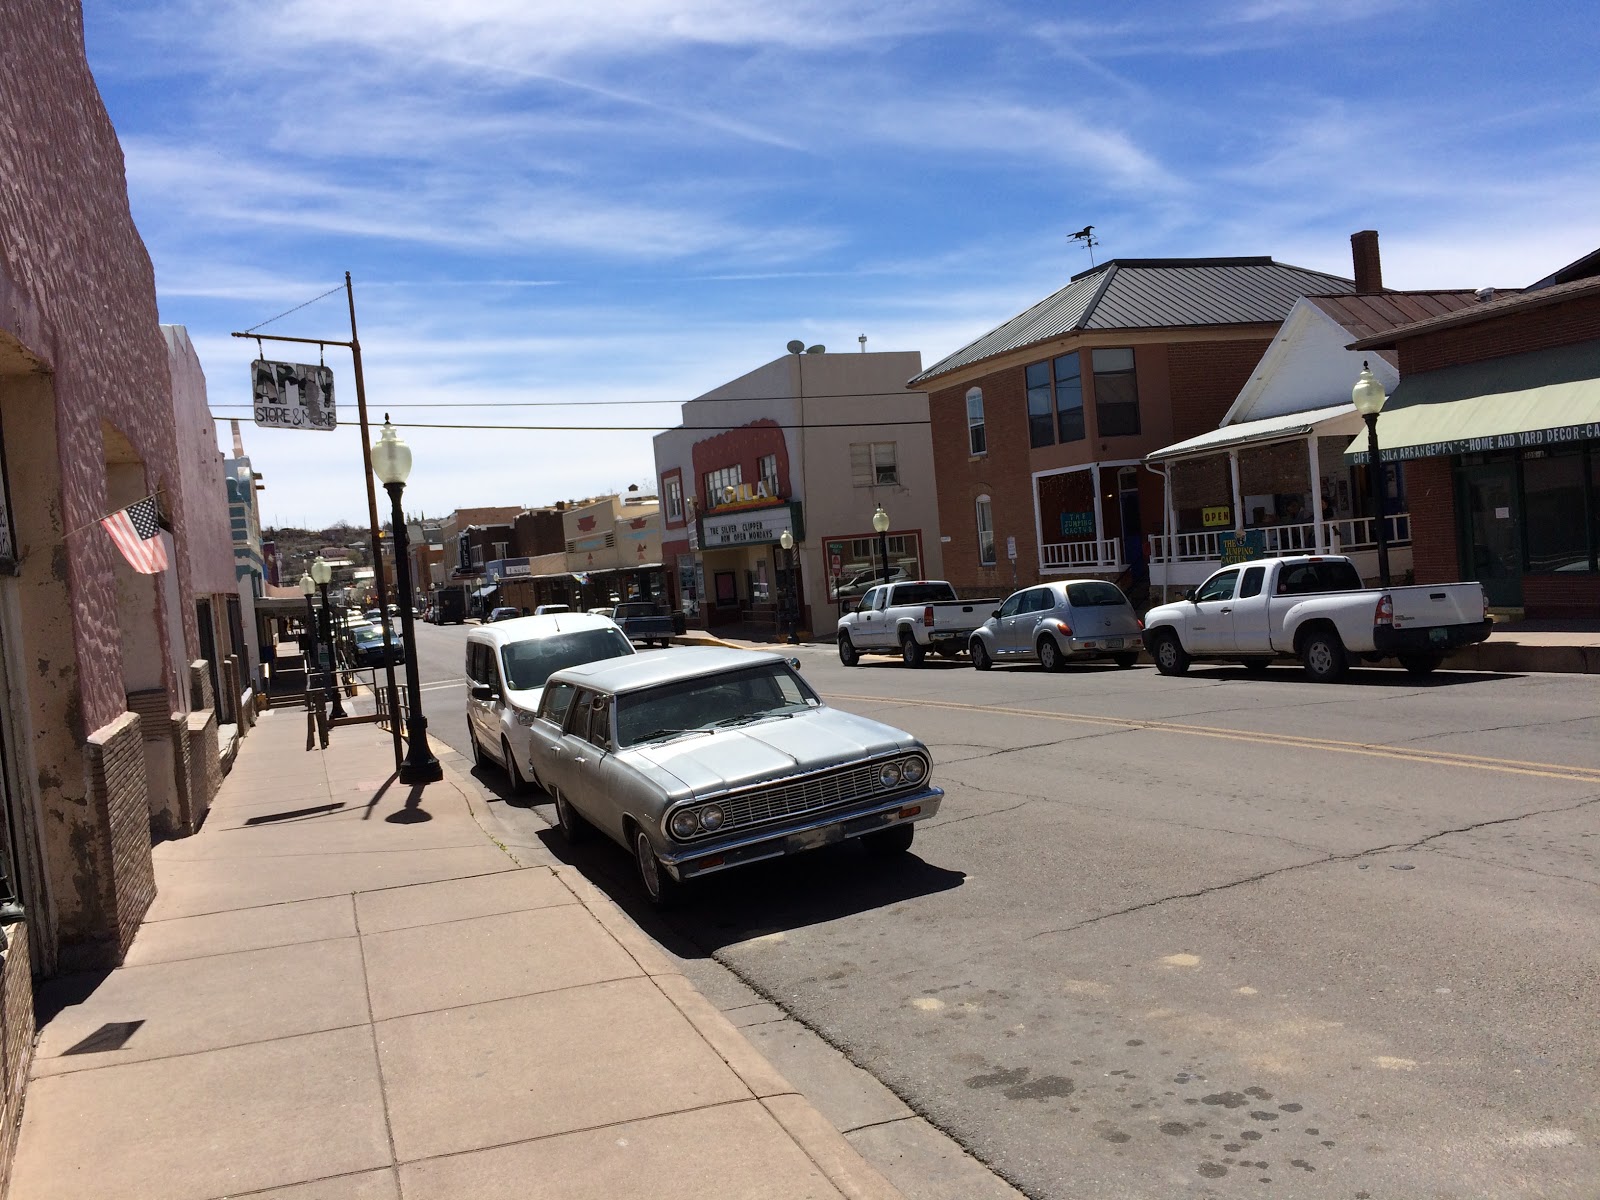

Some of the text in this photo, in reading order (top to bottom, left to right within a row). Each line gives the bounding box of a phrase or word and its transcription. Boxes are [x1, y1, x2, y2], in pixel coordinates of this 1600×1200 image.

[256, 407, 291, 423] STORE
[1497, 434, 1516, 448] AND
[1519, 430, 1543, 446] YARD
[722, 480, 772, 504] GILA
[1204, 511, 1229, 522] OPEN
[721, 525, 737, 533] SILVER
[742, 521, 763, 531] CLIPPER
[733, 532, 747, 540] OPEN
[749, 530, 773, 539] MONDAYS
[1223, 539, 1237, 548] THE
[1226, 546, 1254, 556] JUMPING
